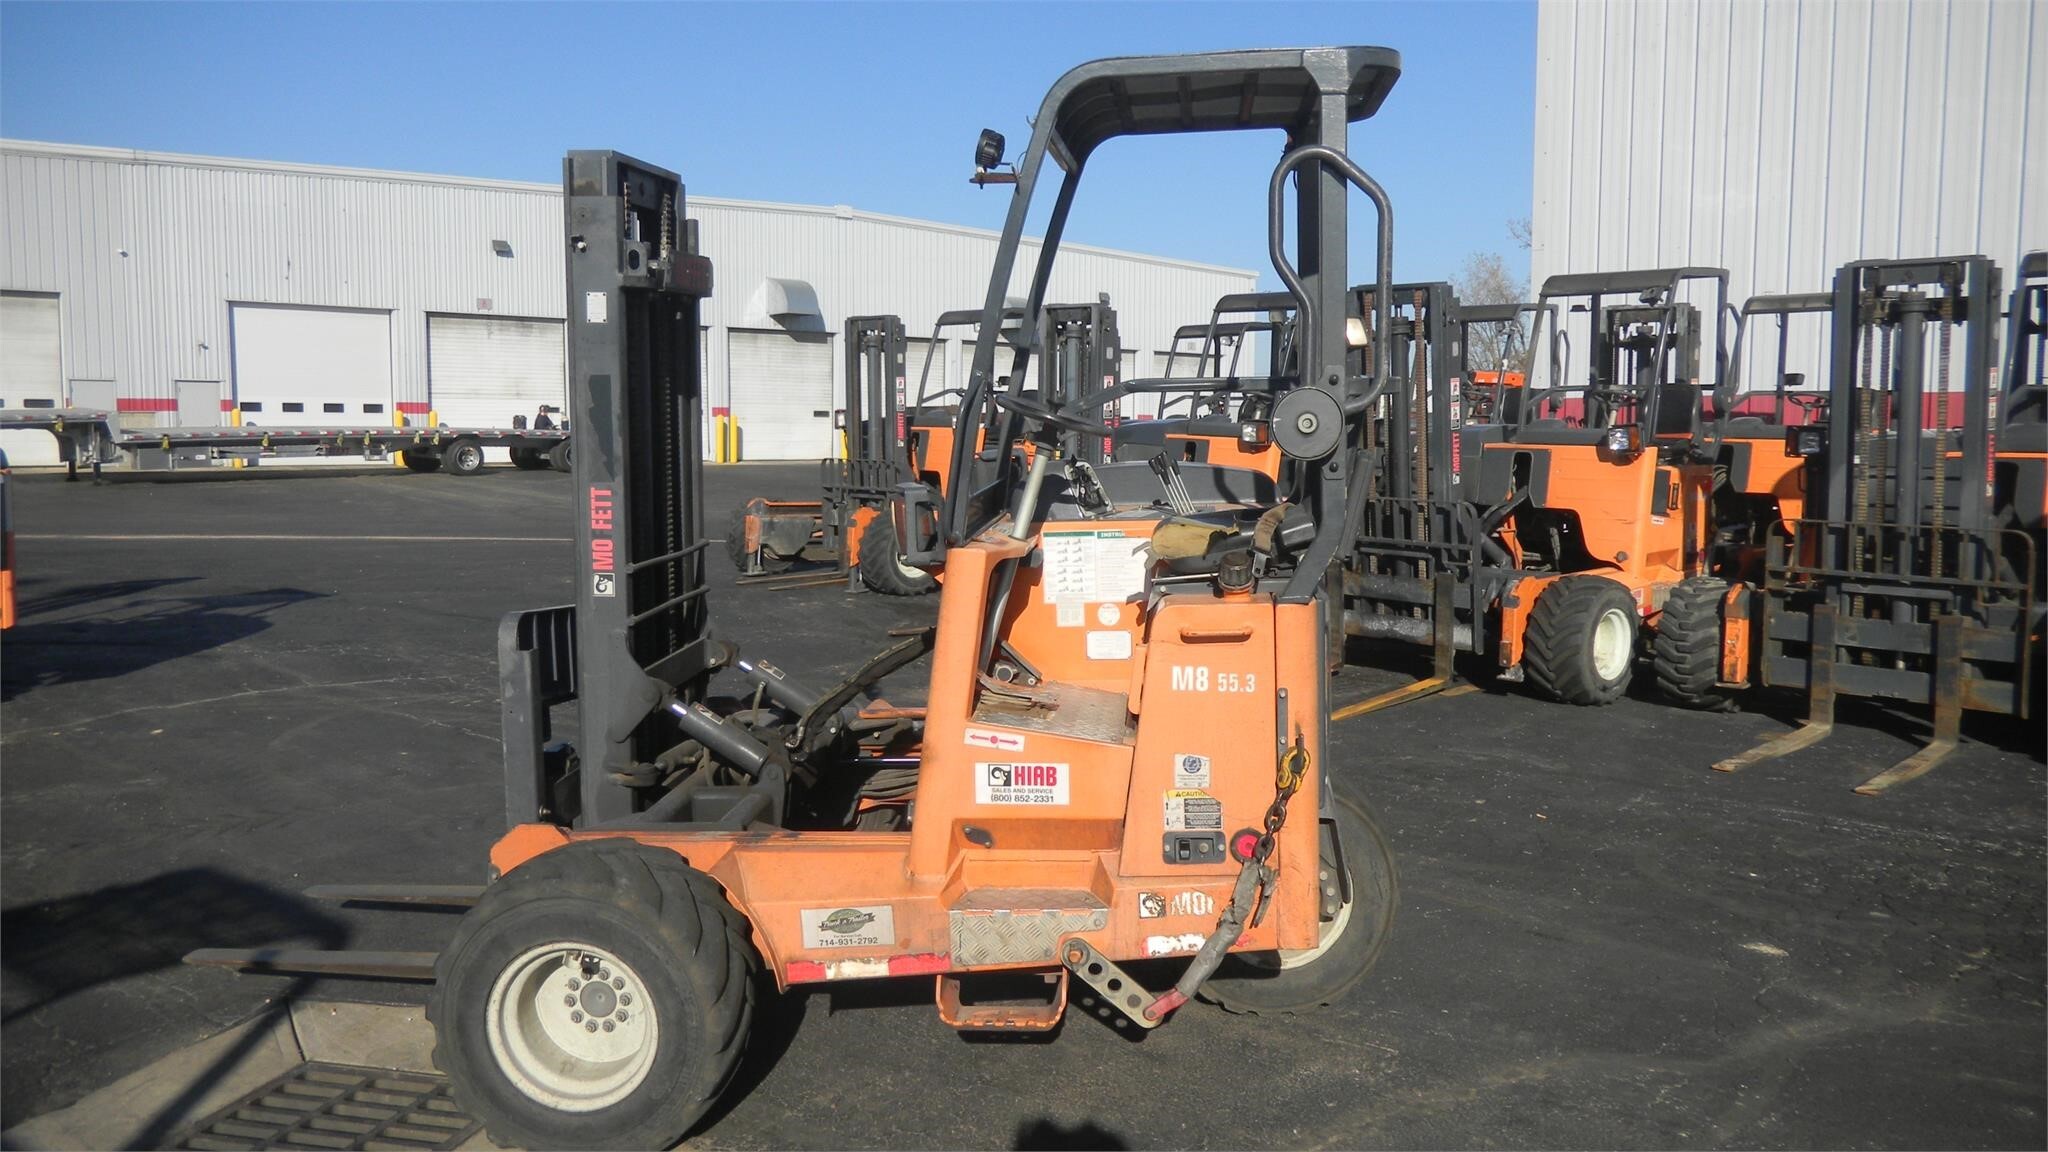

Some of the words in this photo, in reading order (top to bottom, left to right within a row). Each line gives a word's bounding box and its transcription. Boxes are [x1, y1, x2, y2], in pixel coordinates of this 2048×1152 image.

[1171, 665, 1209, 692] M8
[1217, 672, 1256, 693] 55.3
[1014, 765, 1057, 787] HIAB
[991, 794, 1012, 803] (800)
[1014, 794, 1054, 803] 852-2331
[819, 936, 879, 947] 714-931-2792
